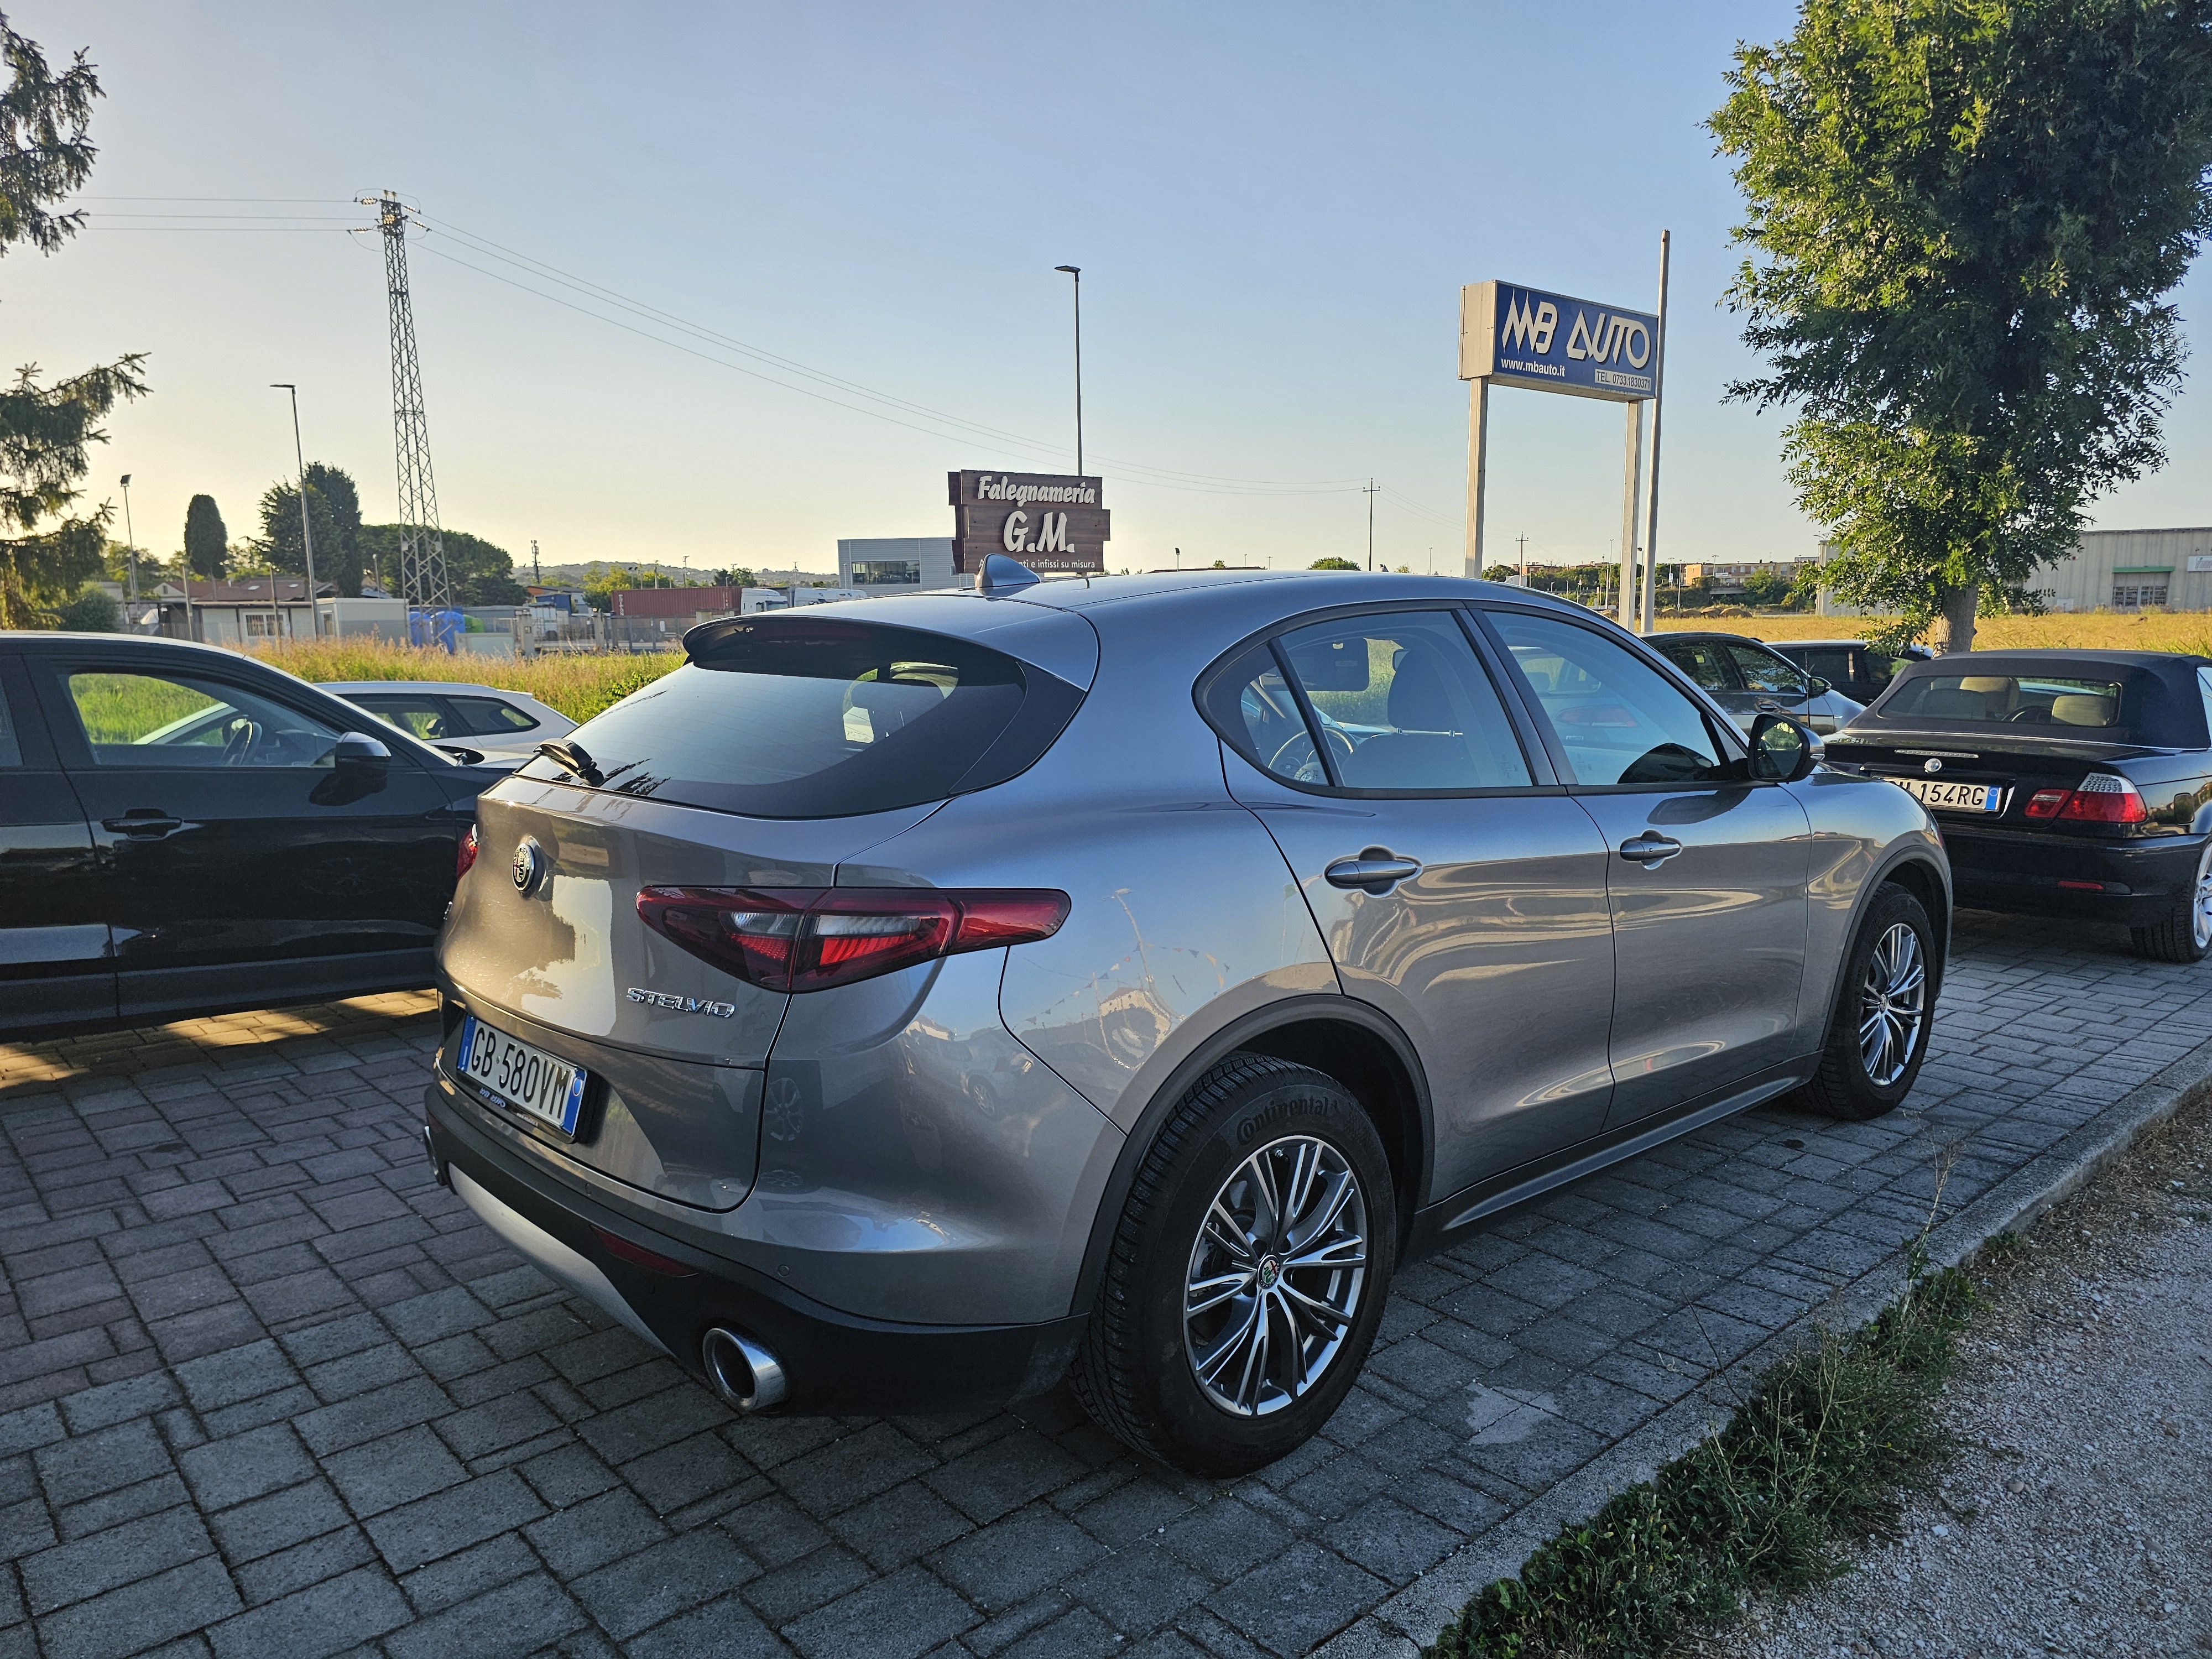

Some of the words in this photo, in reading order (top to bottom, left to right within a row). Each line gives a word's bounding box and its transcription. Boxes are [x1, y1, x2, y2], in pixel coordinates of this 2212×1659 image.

[1502, 288, 1558, 354] MB
[1566, 309, 1650, 368] AUTO
[1501, 358, 1565, 377] www.mbauto.it
[1597, 371, 1610, 383] TEL.
[1613, 374, 1650, 389] 0733.1830371
[978, 476, 1095, 507] Falegnameria
[1003, 510, 1075, 552] G.M.
[1037, 559, 1059, 568] infissi
[1071, 559, 1095, 568] misura
[626, 988, 735, 1018] STELVIO
[1236, 1095, 1329, 1146] Continental
